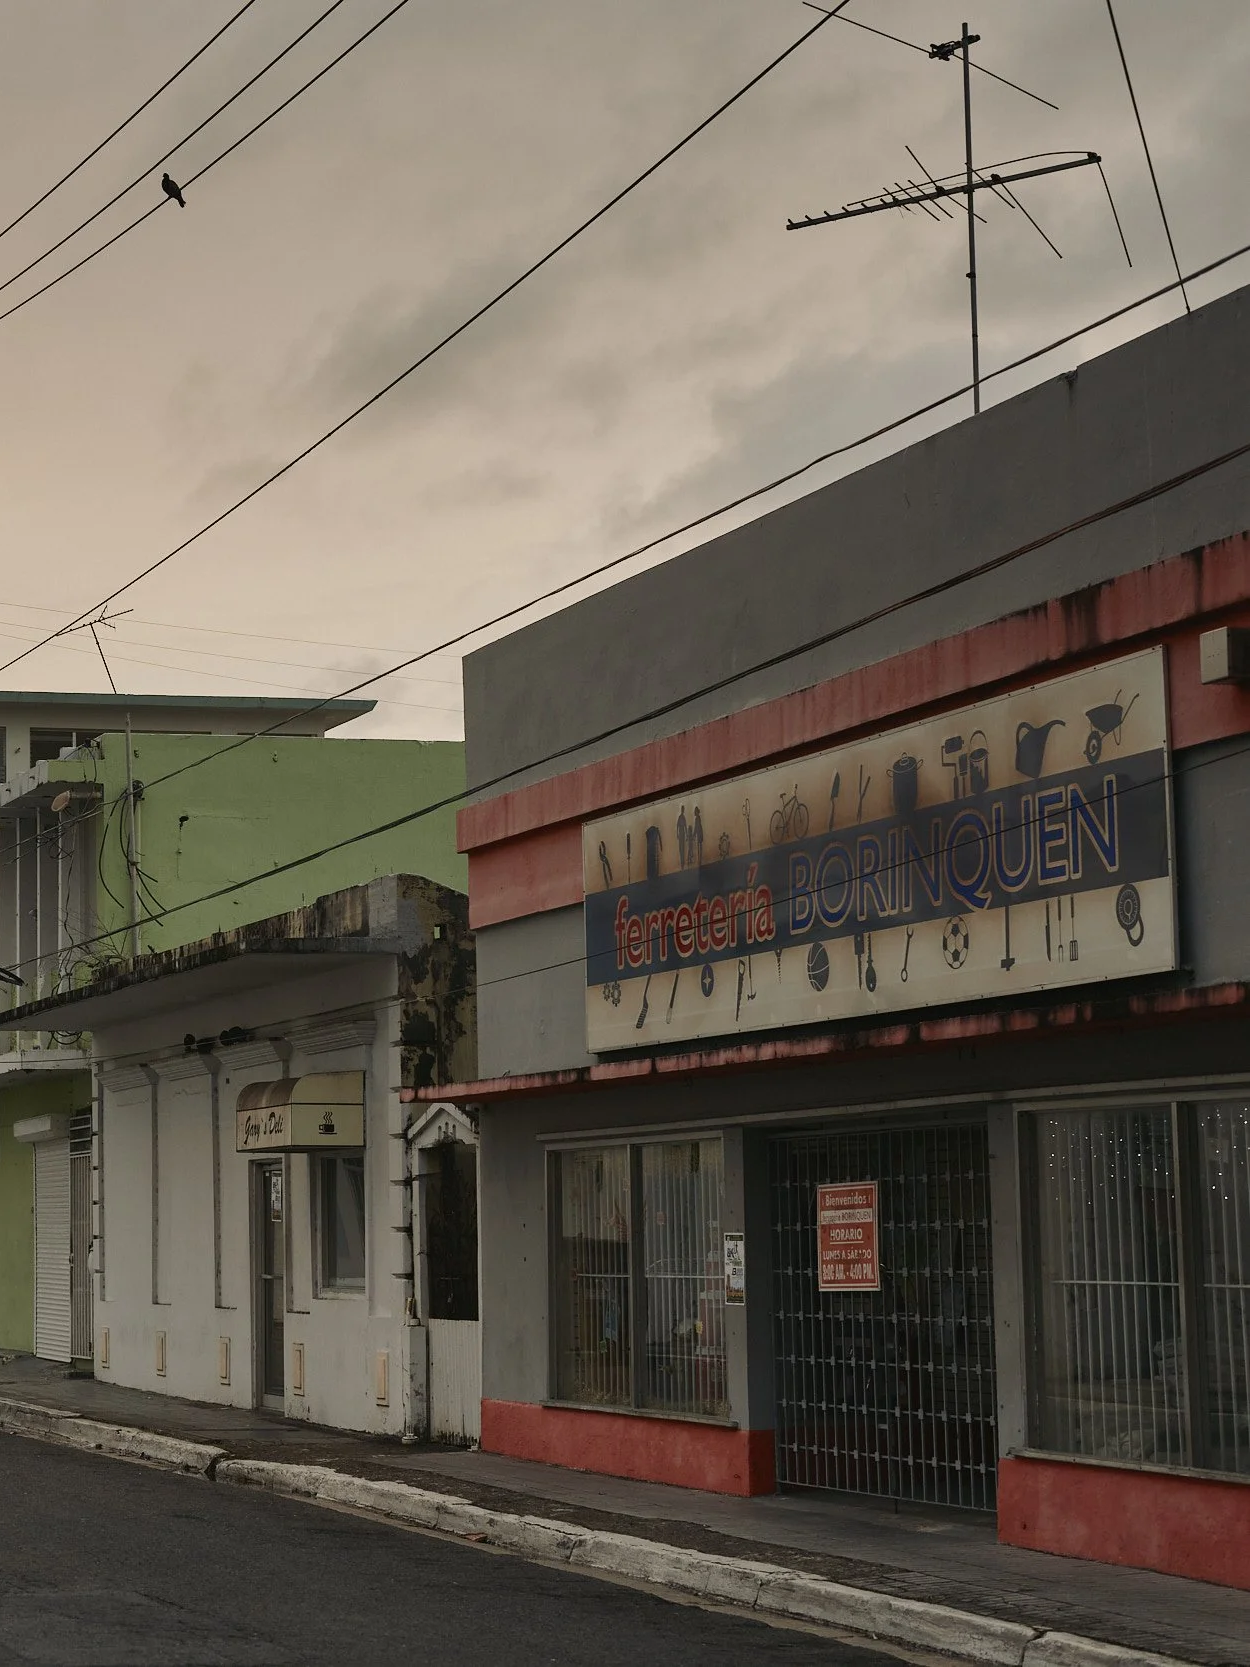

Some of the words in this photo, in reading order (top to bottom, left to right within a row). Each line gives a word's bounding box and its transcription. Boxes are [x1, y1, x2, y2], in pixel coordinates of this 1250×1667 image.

[615, 862, 776, 970] ferretería
[789, 773, 1119, 936] BORINQUEN
[269, 1112, 284, 1135] Deli
[830, 1228, 863, 1241] HORARIO
[823, 1250, 841, 1260] LUNES
[841, 1250, 846, 1260] A
